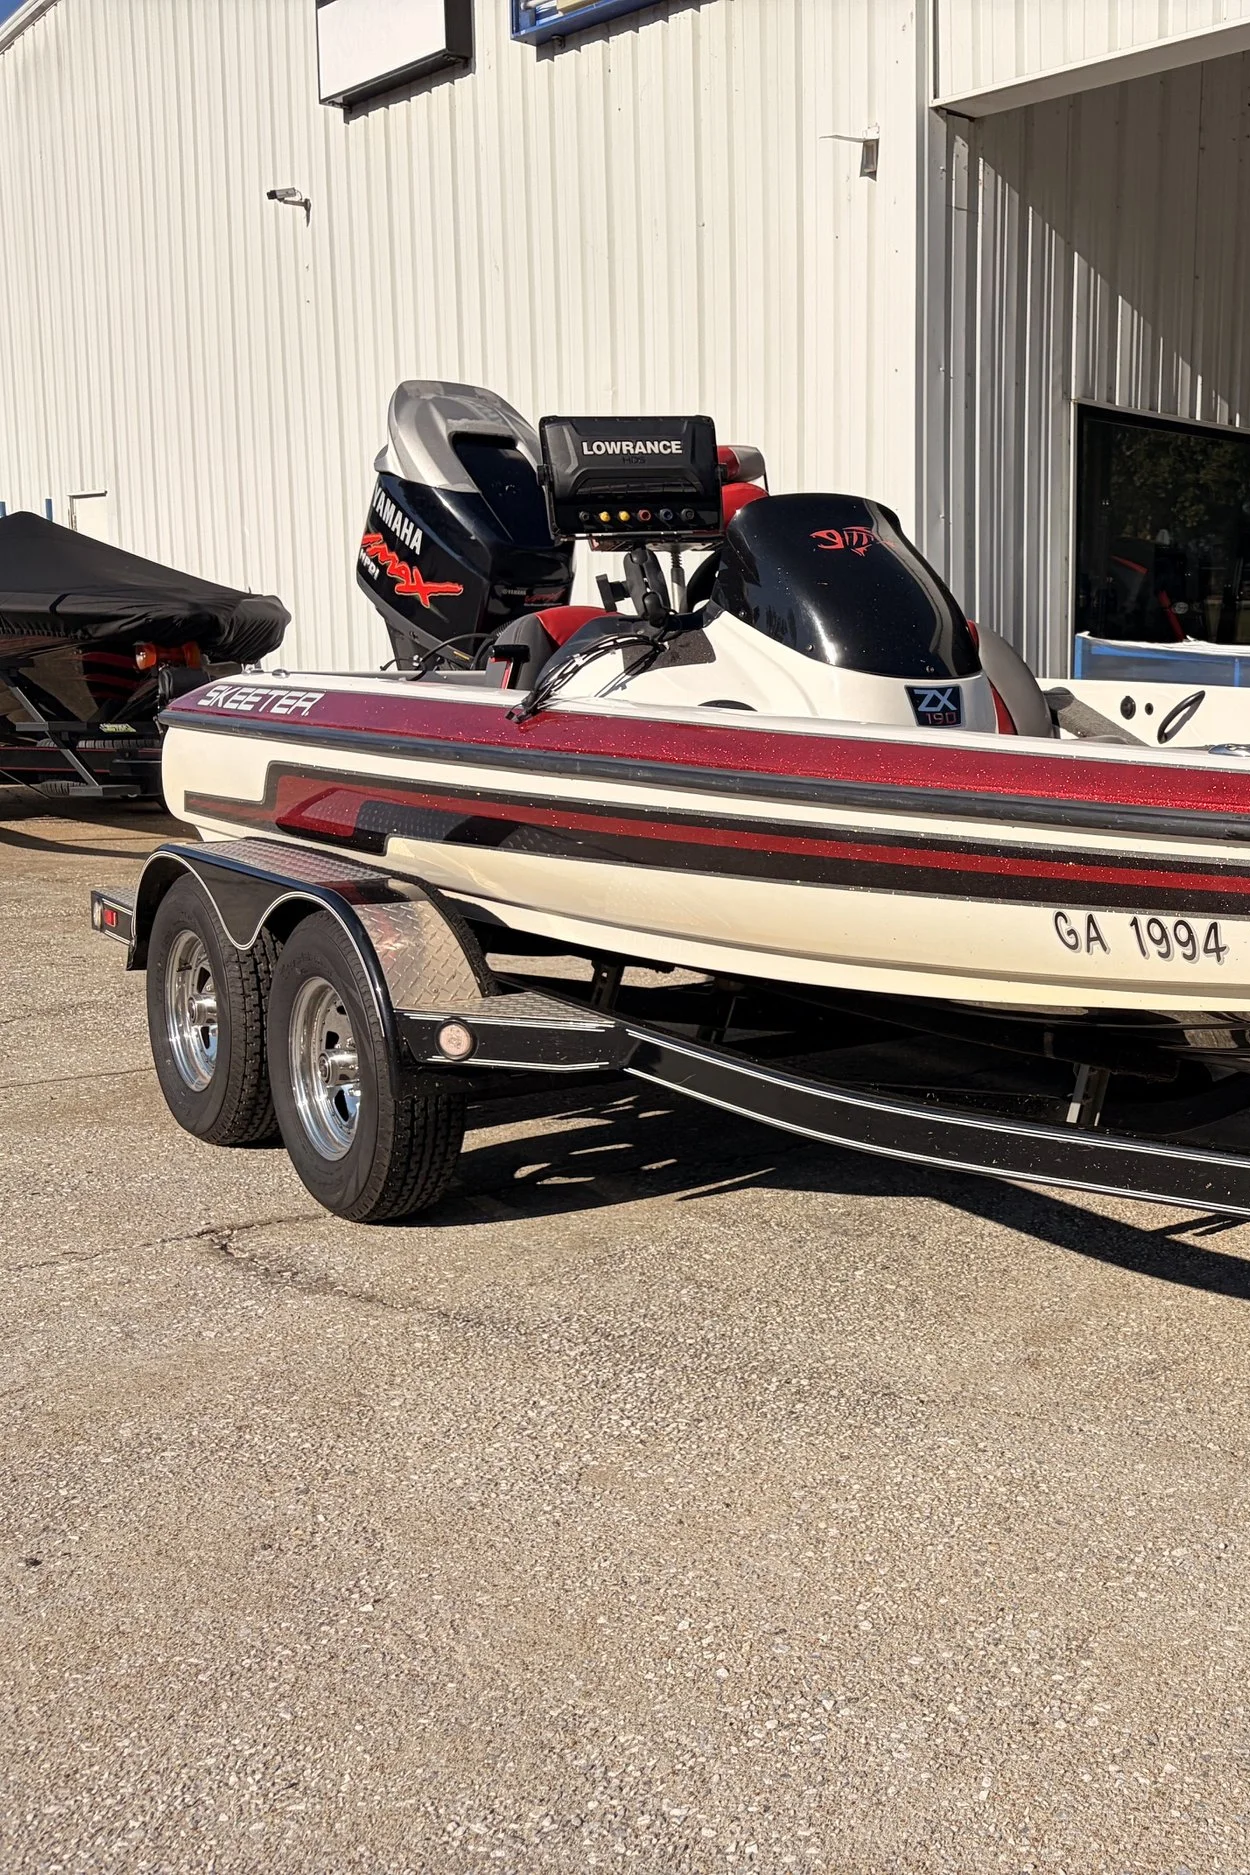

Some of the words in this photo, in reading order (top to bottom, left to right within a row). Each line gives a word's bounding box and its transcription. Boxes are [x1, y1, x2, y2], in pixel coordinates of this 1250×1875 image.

[582, 440, 683, 455] LOWRANCE
[372, 486, 423, 555] YAMAHA
[197, 685, 326, 716] SKEETER
[914, 688, 957, 711] ZX
[926, 712, 957, 725] 190
[1054, 911, 1109, 955] GA
[1129, 916, 1229, 963] 1994
